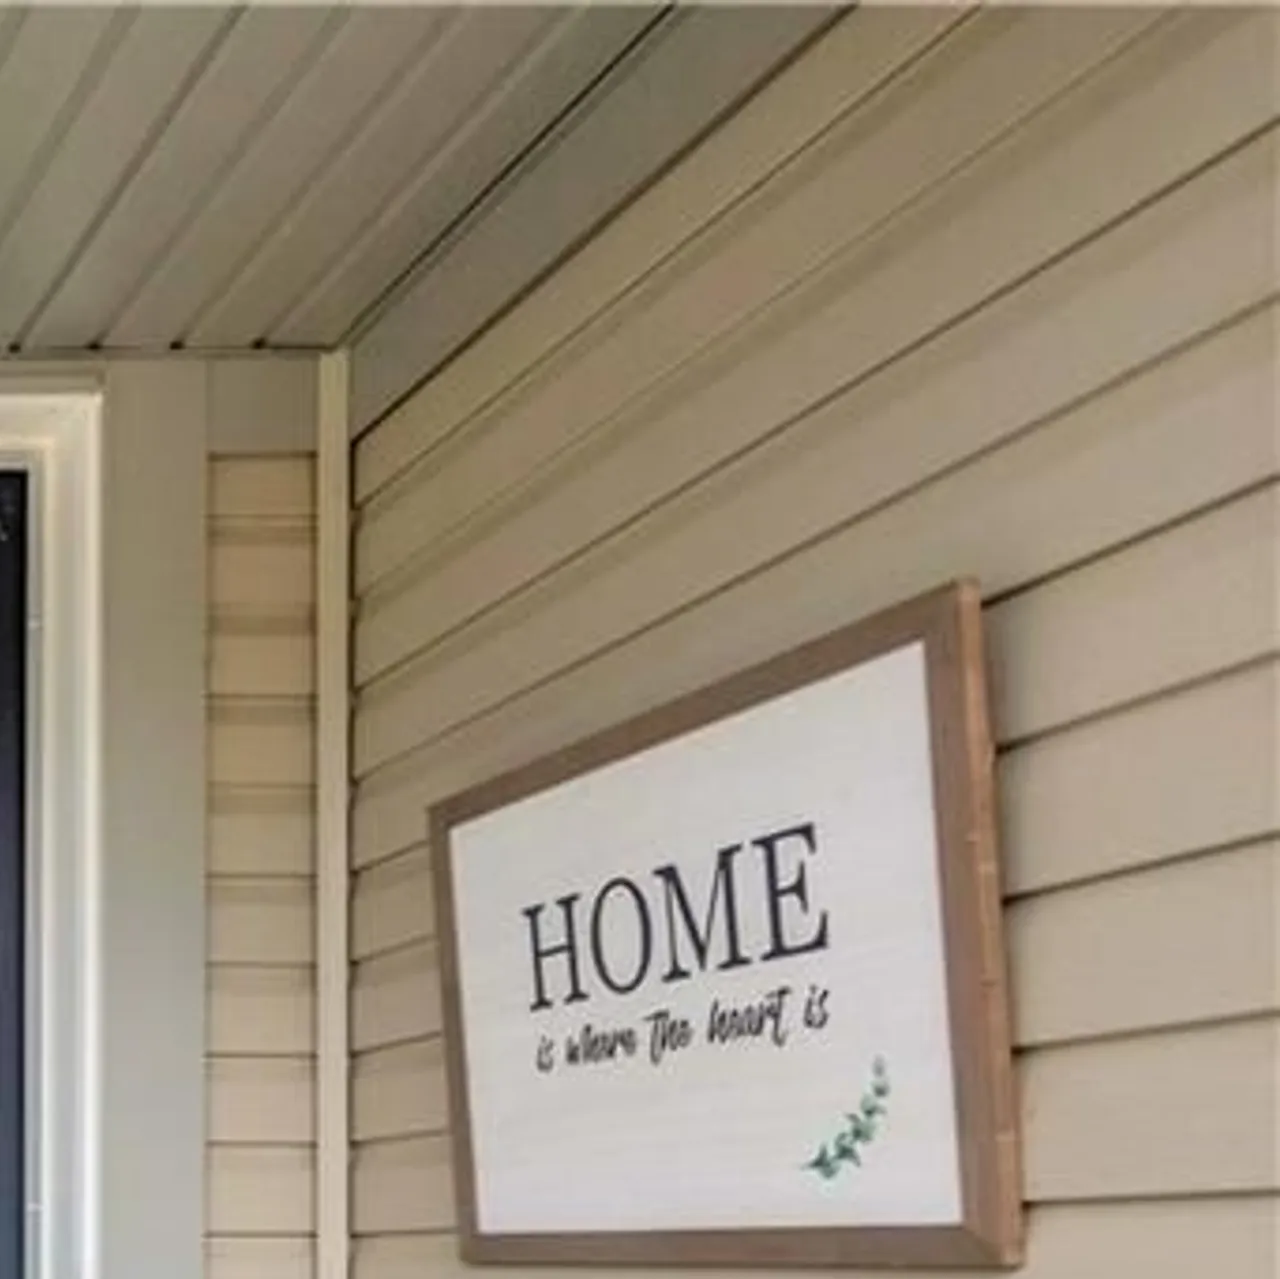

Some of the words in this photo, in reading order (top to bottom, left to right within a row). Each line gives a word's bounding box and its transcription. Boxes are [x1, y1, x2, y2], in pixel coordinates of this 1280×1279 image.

[521, 822, 830, 1012] HOME
[537, 1035, 554, 1072] is
[566, 1023, 637, 1066] where
[707, 986, 791, 1048] heart
[803, 985, 829, 1029] is
